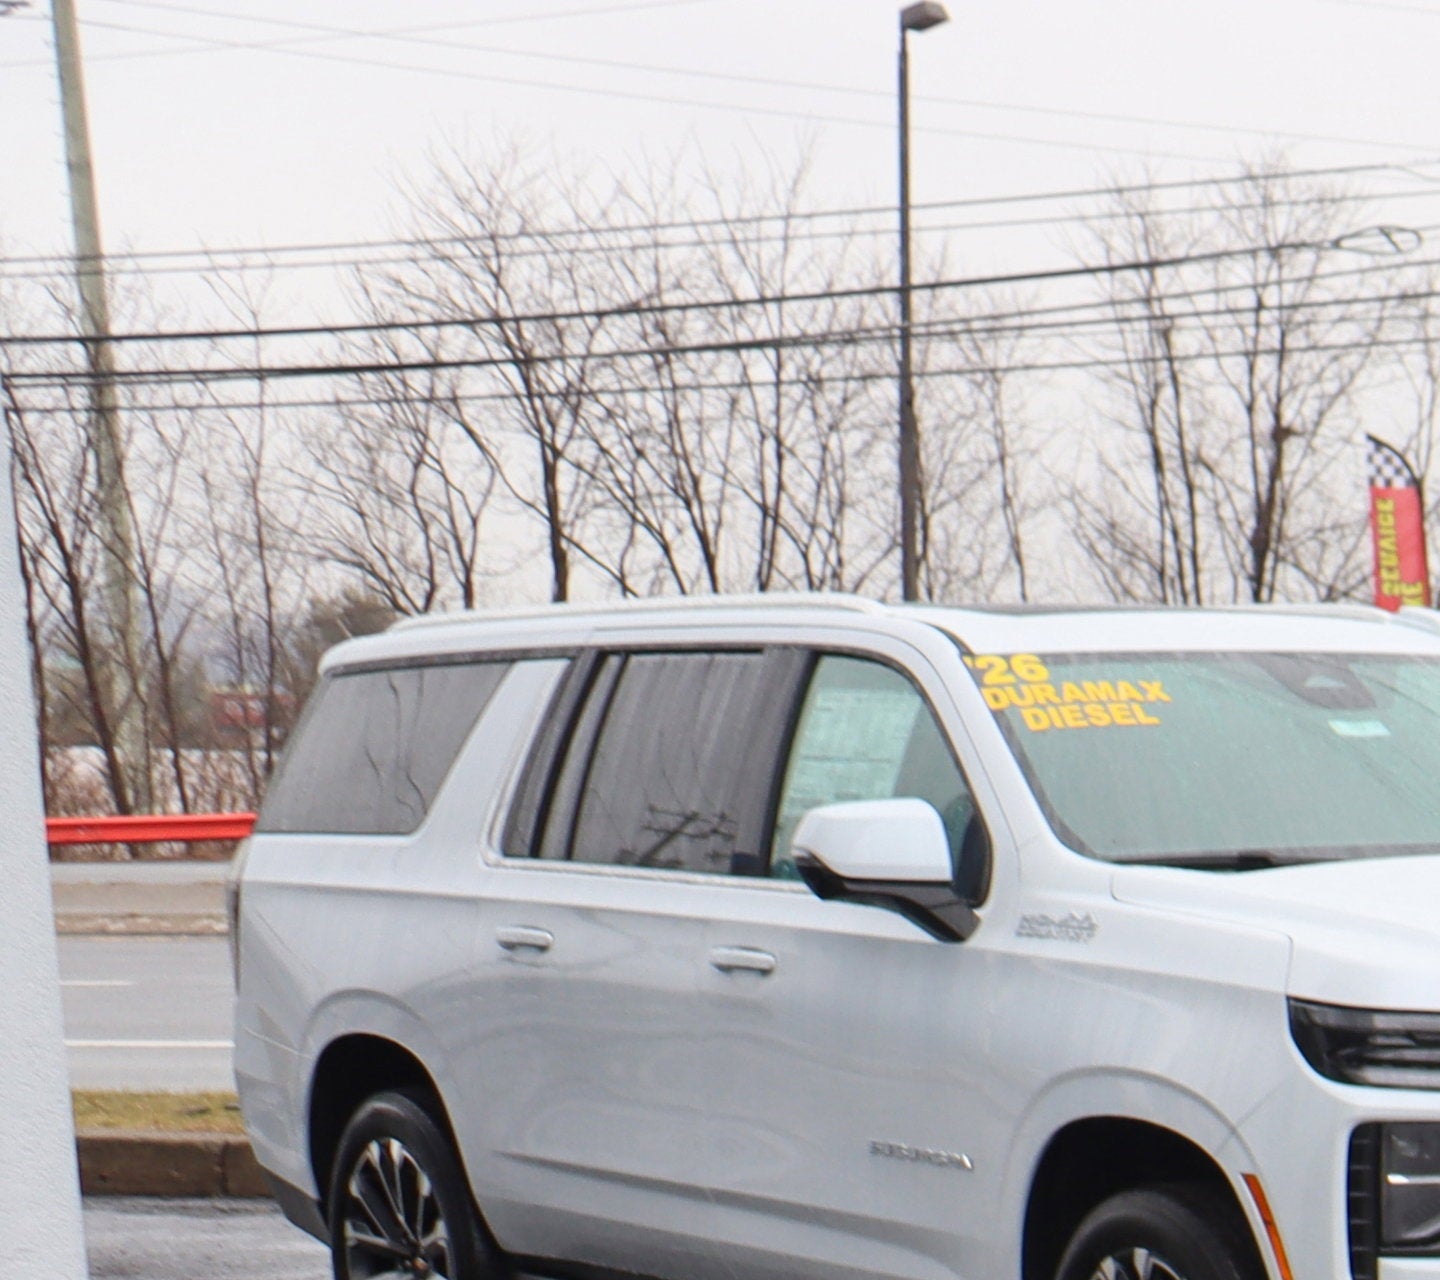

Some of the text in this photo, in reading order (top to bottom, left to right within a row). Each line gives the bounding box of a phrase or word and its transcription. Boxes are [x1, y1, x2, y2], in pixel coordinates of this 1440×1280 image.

[963, 655, 1049, 685] '26
[982, 680, 1171, 710] DURAMAX
[1022, 703, 1160, 732] DIESEL
